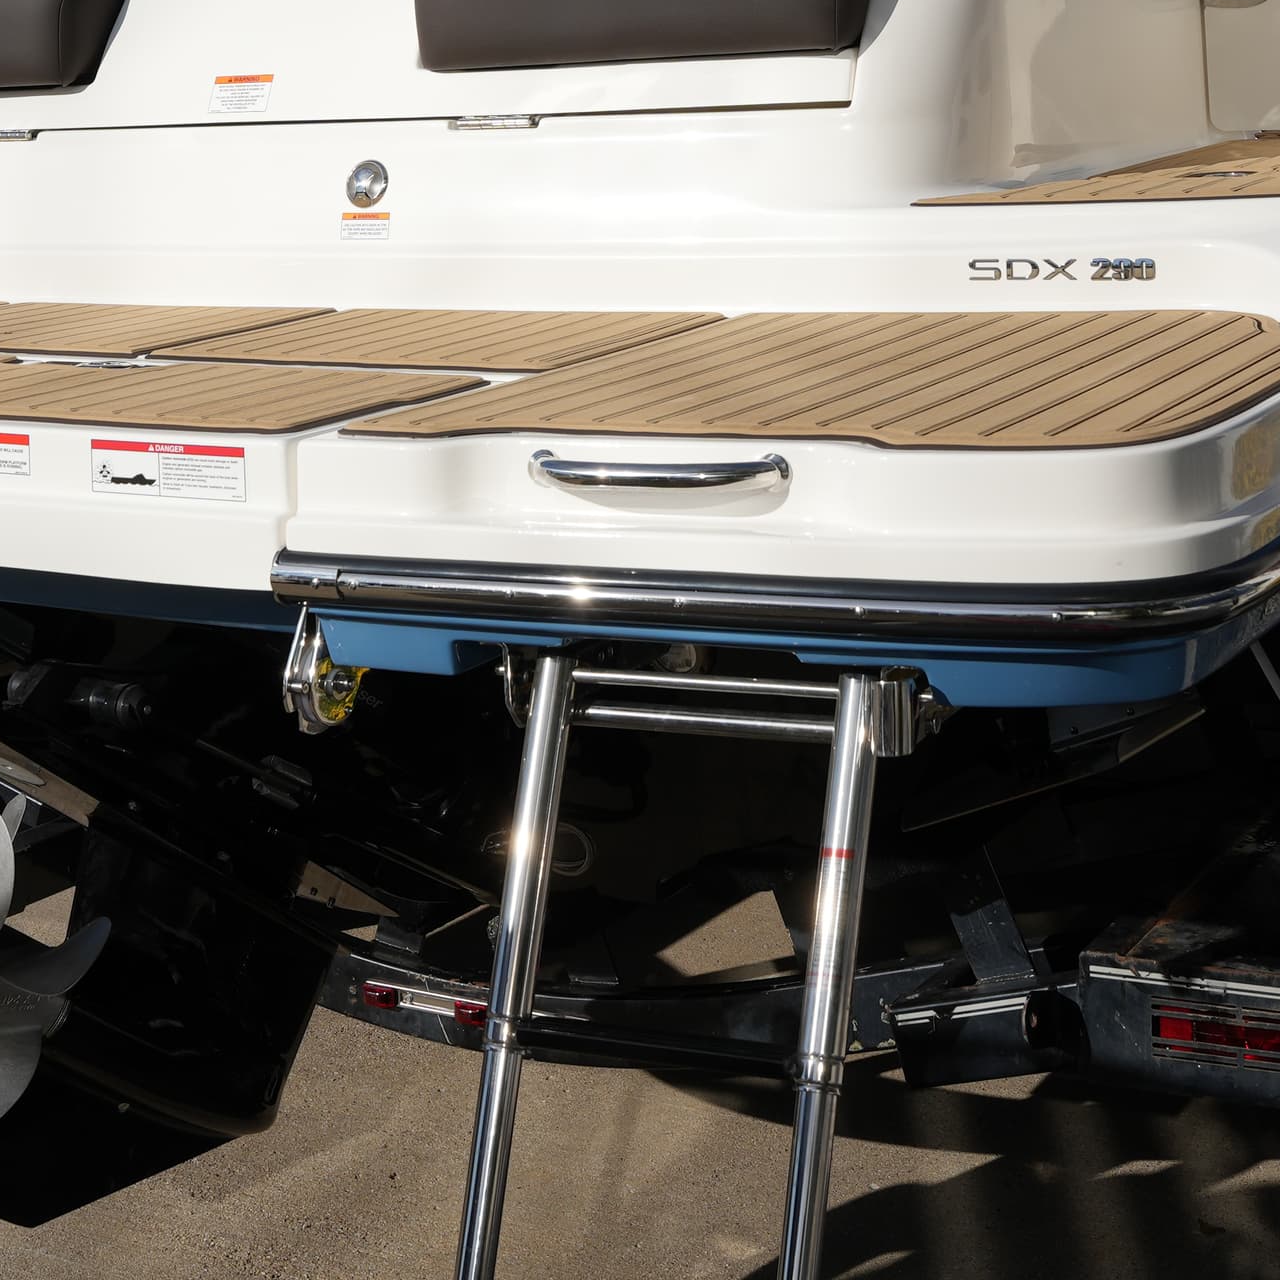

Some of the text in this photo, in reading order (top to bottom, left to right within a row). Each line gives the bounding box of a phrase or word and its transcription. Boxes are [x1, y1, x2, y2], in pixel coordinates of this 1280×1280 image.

[968, 257, 1157, 281] SDX 290
[155, 444, 185, 453] DANGER
